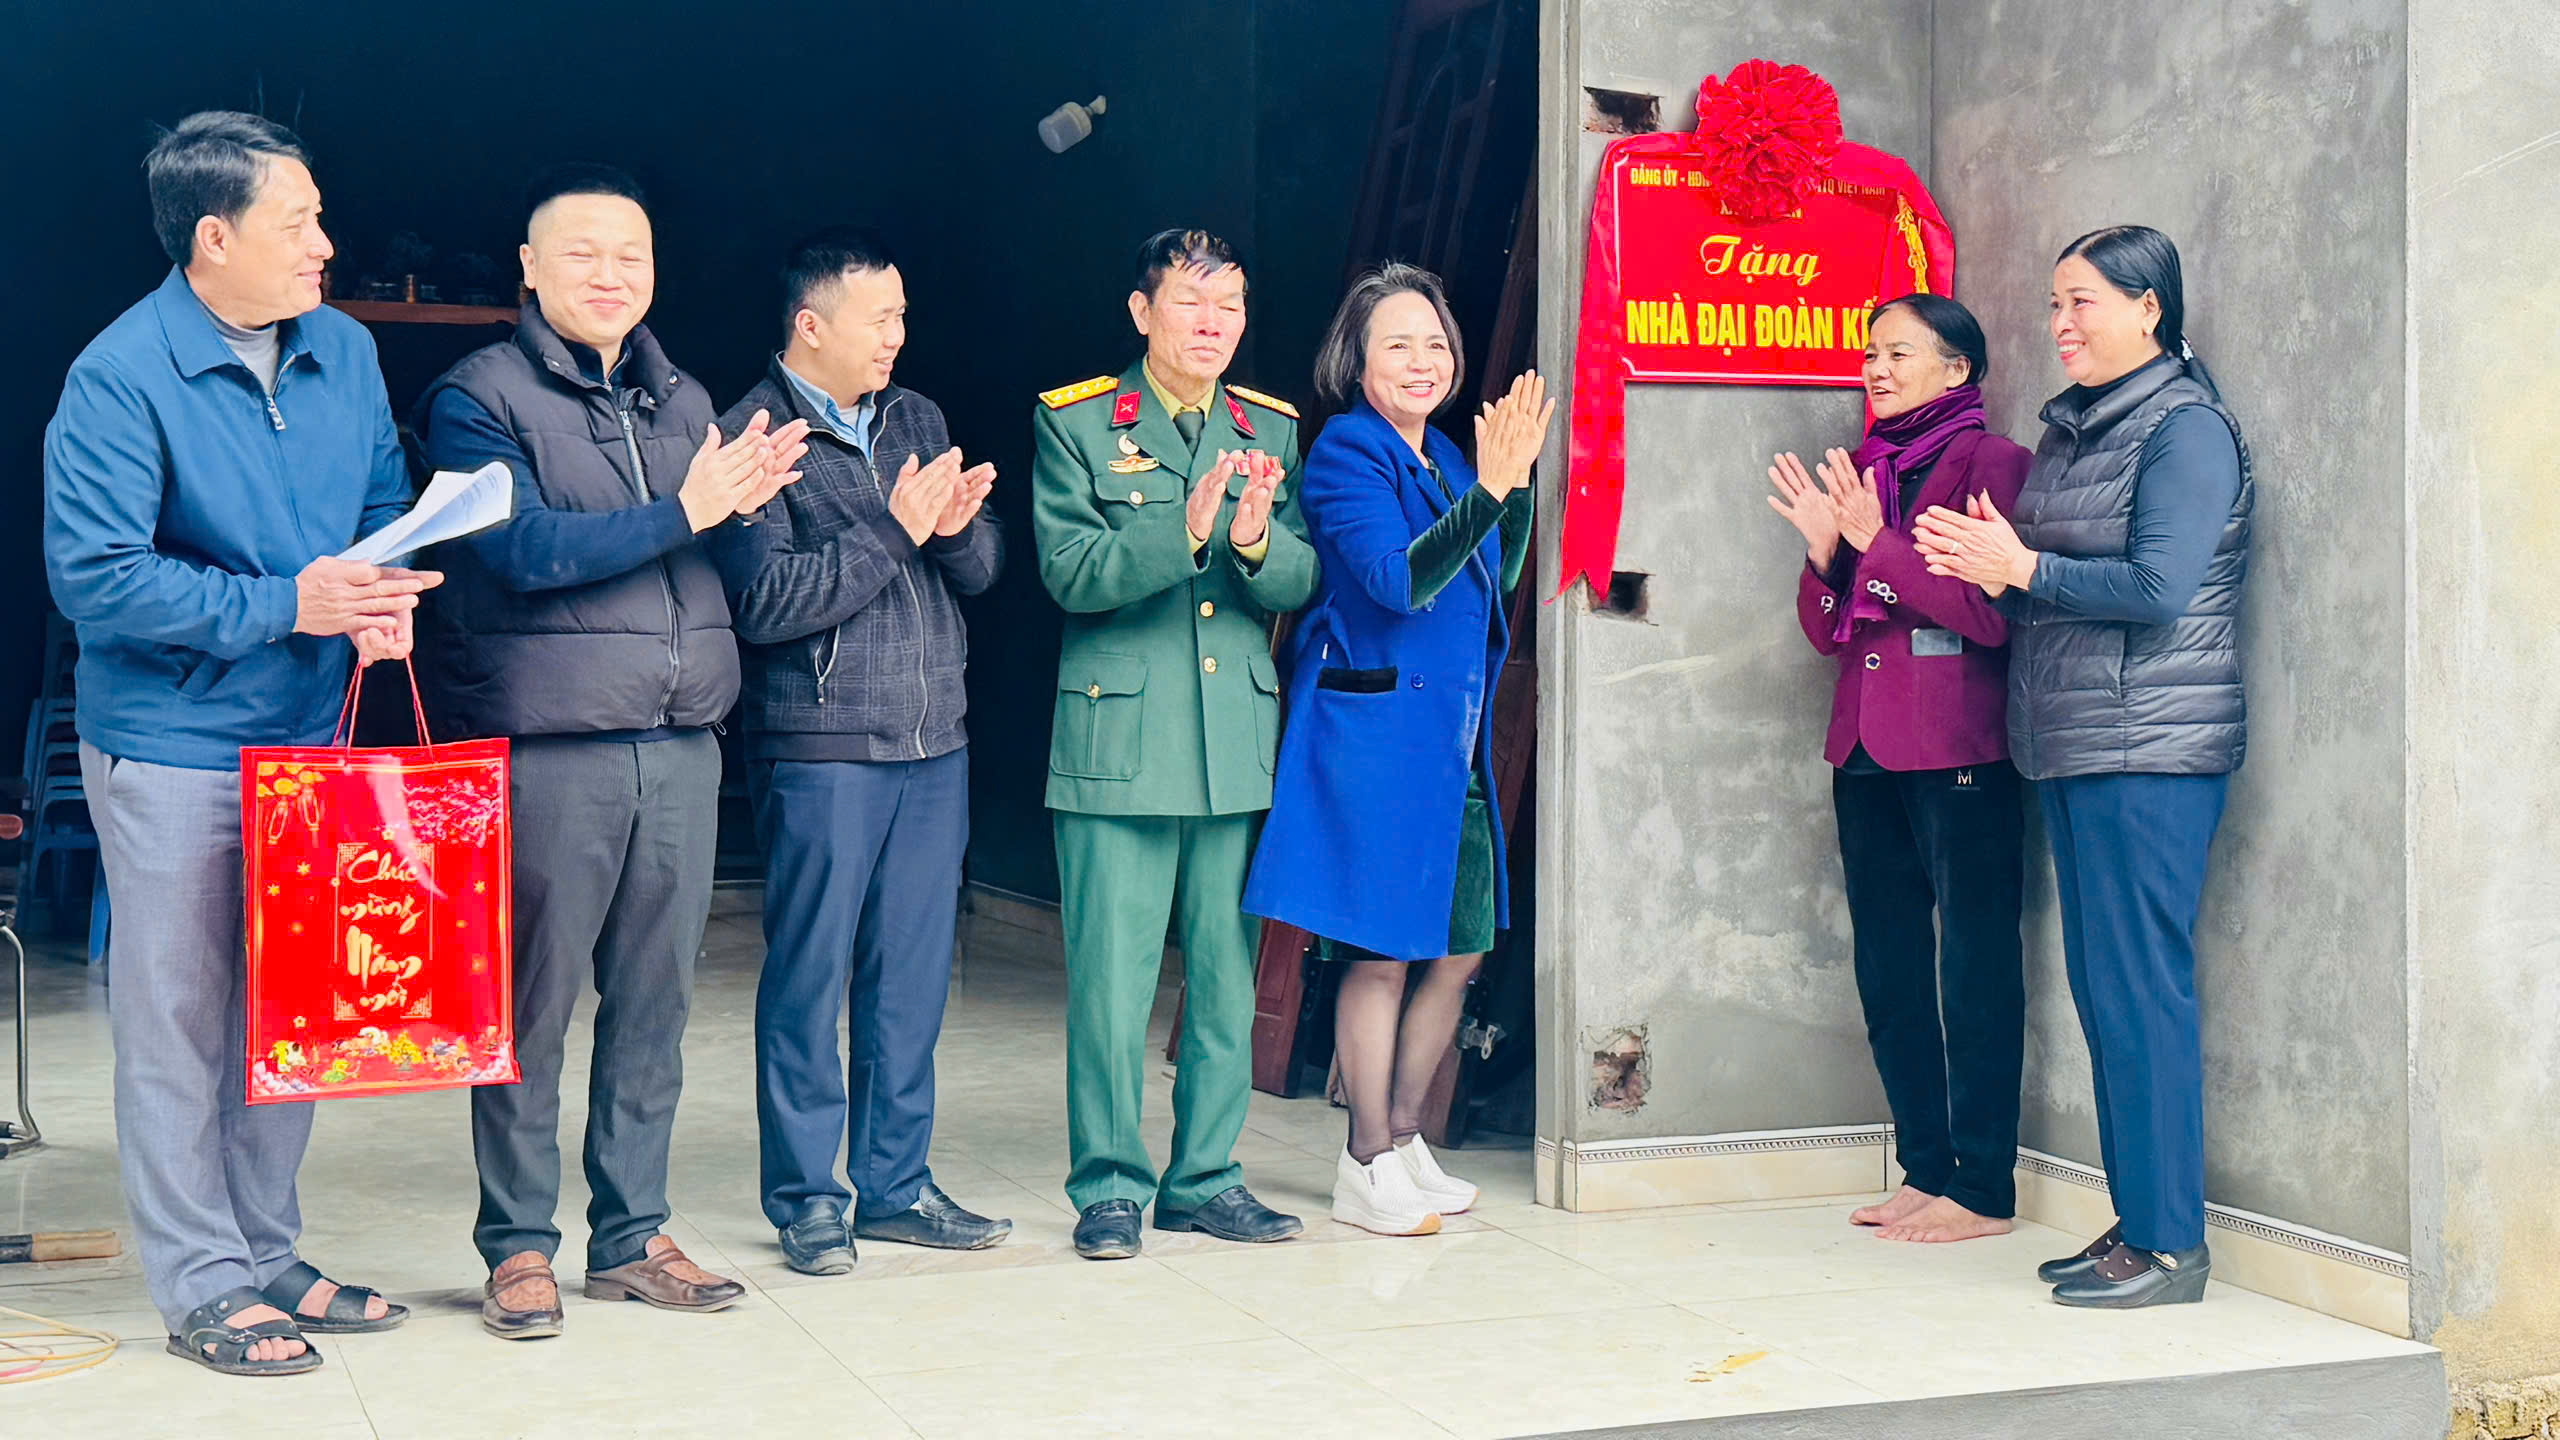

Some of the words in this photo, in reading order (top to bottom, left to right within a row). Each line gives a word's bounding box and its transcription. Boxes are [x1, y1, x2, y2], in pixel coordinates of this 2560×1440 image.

[1630, 162, 1661, 186] ĐẢNG
[1663, 163, 1678, 187] ỦY
[1700, 234, 1822, 286] Tặng
[1626, 292, 1690, 345] NHÀ
[1697, 302, 1746, 356] ĐẠI
[1755, 296, 1834, 350] ĐOÀN
[1842, 295, 1879, 350] KẾ
[347, 849, 418, 883] Chúc
[339, 892, 425, 935] mừng
[345, 924, 423, 990] Năm
[359, 973, 408, 1013] mới
